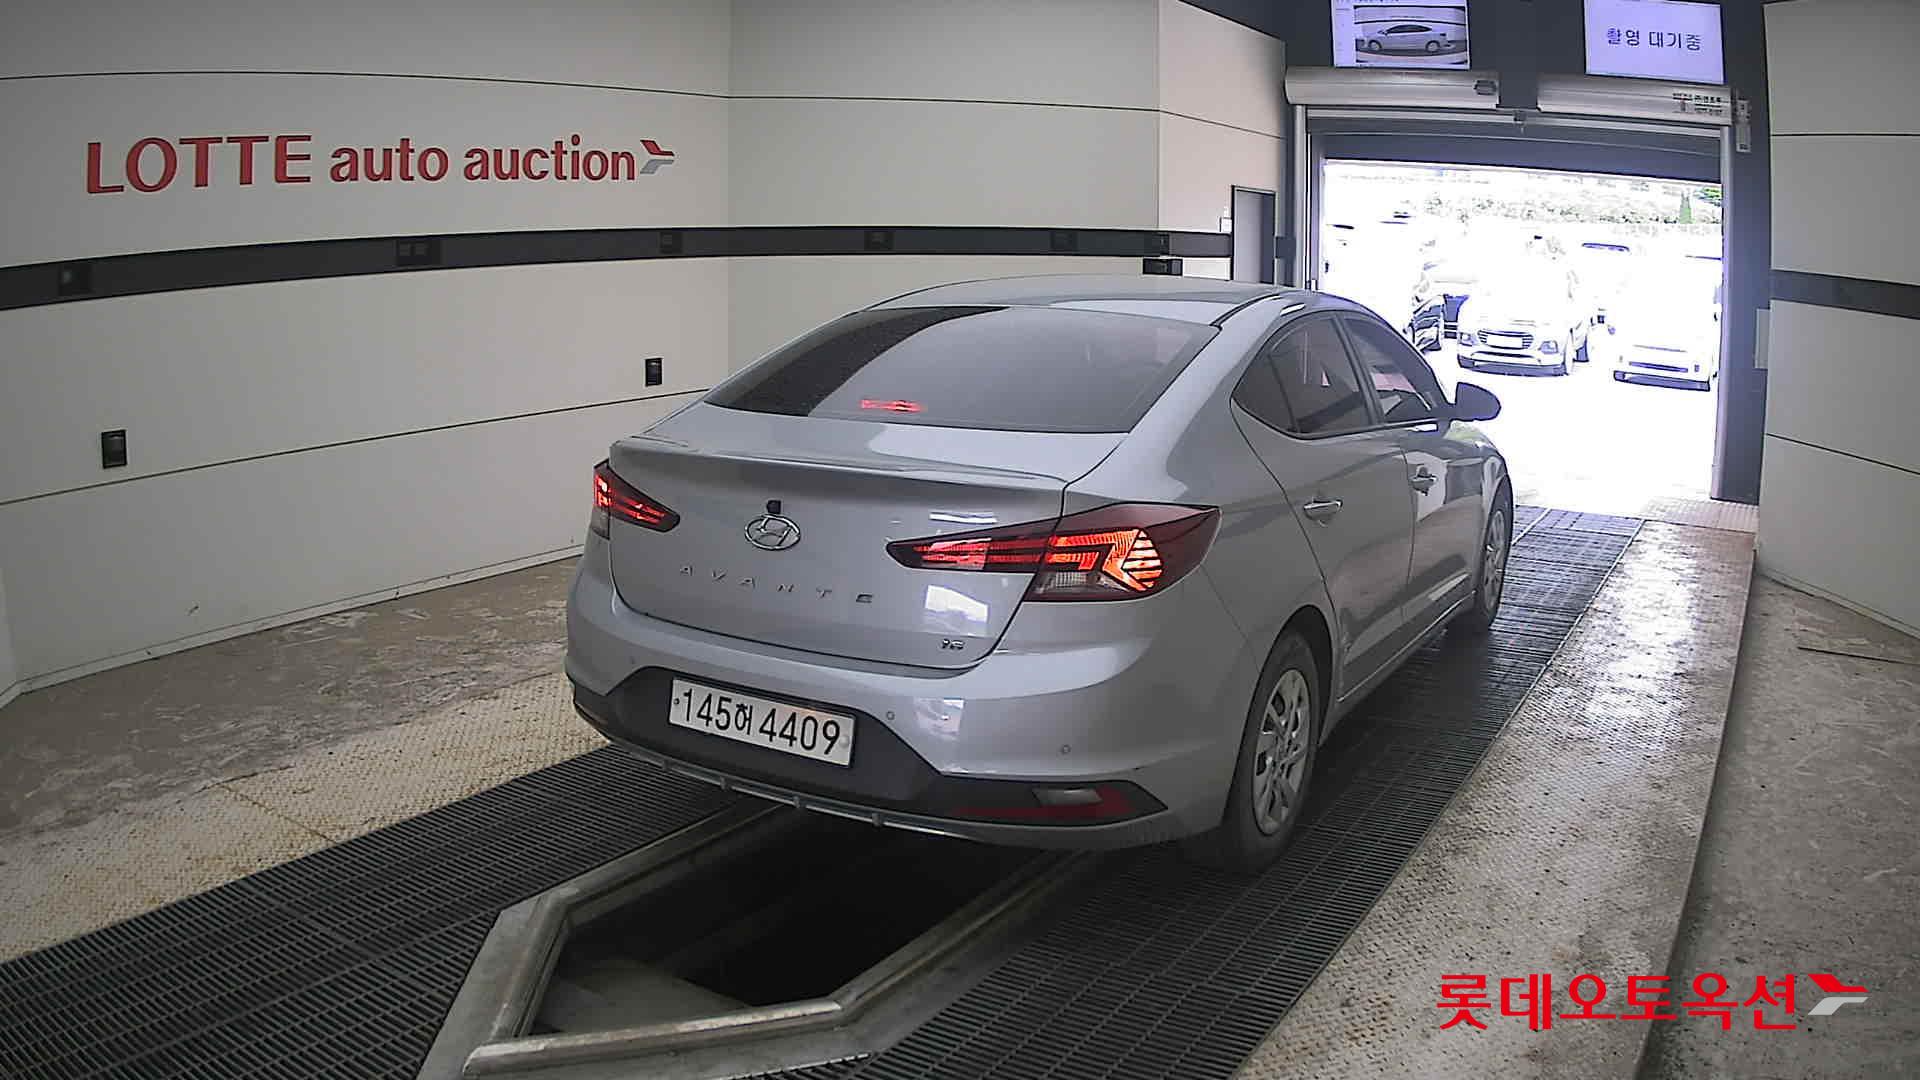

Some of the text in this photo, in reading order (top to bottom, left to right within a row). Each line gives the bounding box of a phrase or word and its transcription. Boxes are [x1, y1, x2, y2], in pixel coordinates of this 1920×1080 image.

[88, 134, 636, 194] LOTTE auto auction
[679, 564, 875, 604] AVANTE
